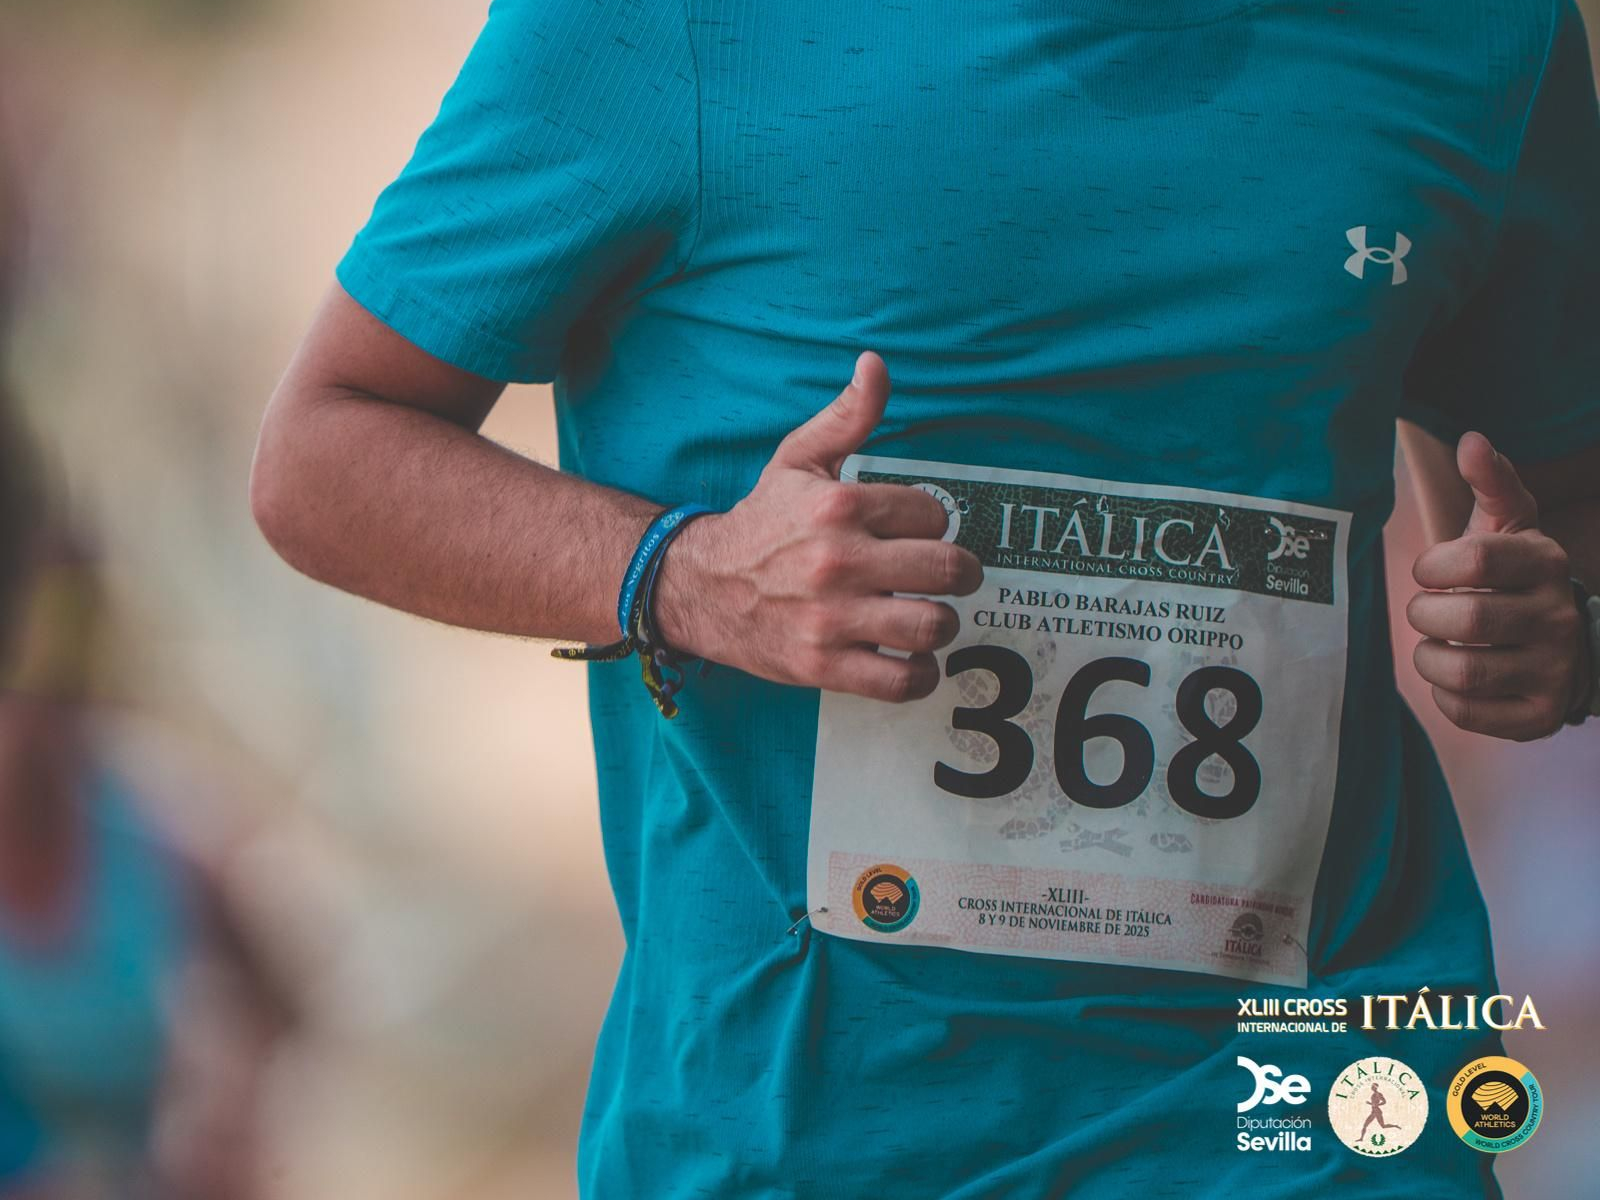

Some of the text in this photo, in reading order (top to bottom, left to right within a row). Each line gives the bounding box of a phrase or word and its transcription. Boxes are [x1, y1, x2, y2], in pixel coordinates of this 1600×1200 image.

[996, 497, 1236, 571] ITÁLICA
[996, 553, 1234, 586] INTERNATIONAL CROSS COUNTRY
[1265, 573, 1309, 596] Sevilla
[998, 587, 1226, 624] PABLO BARAJAS RUIZ
[972, 609, 1245, 651] CLUB ATLETISMO ORIPPO
[933, 644, 1264, 821] 368
[958, 897, 1172, 926] CROSS INTERNACIONAL DE ITÁLICA
[978, 913, 1150, 938] 8 Y 9 DE NOVIEMBRE DE 2025
